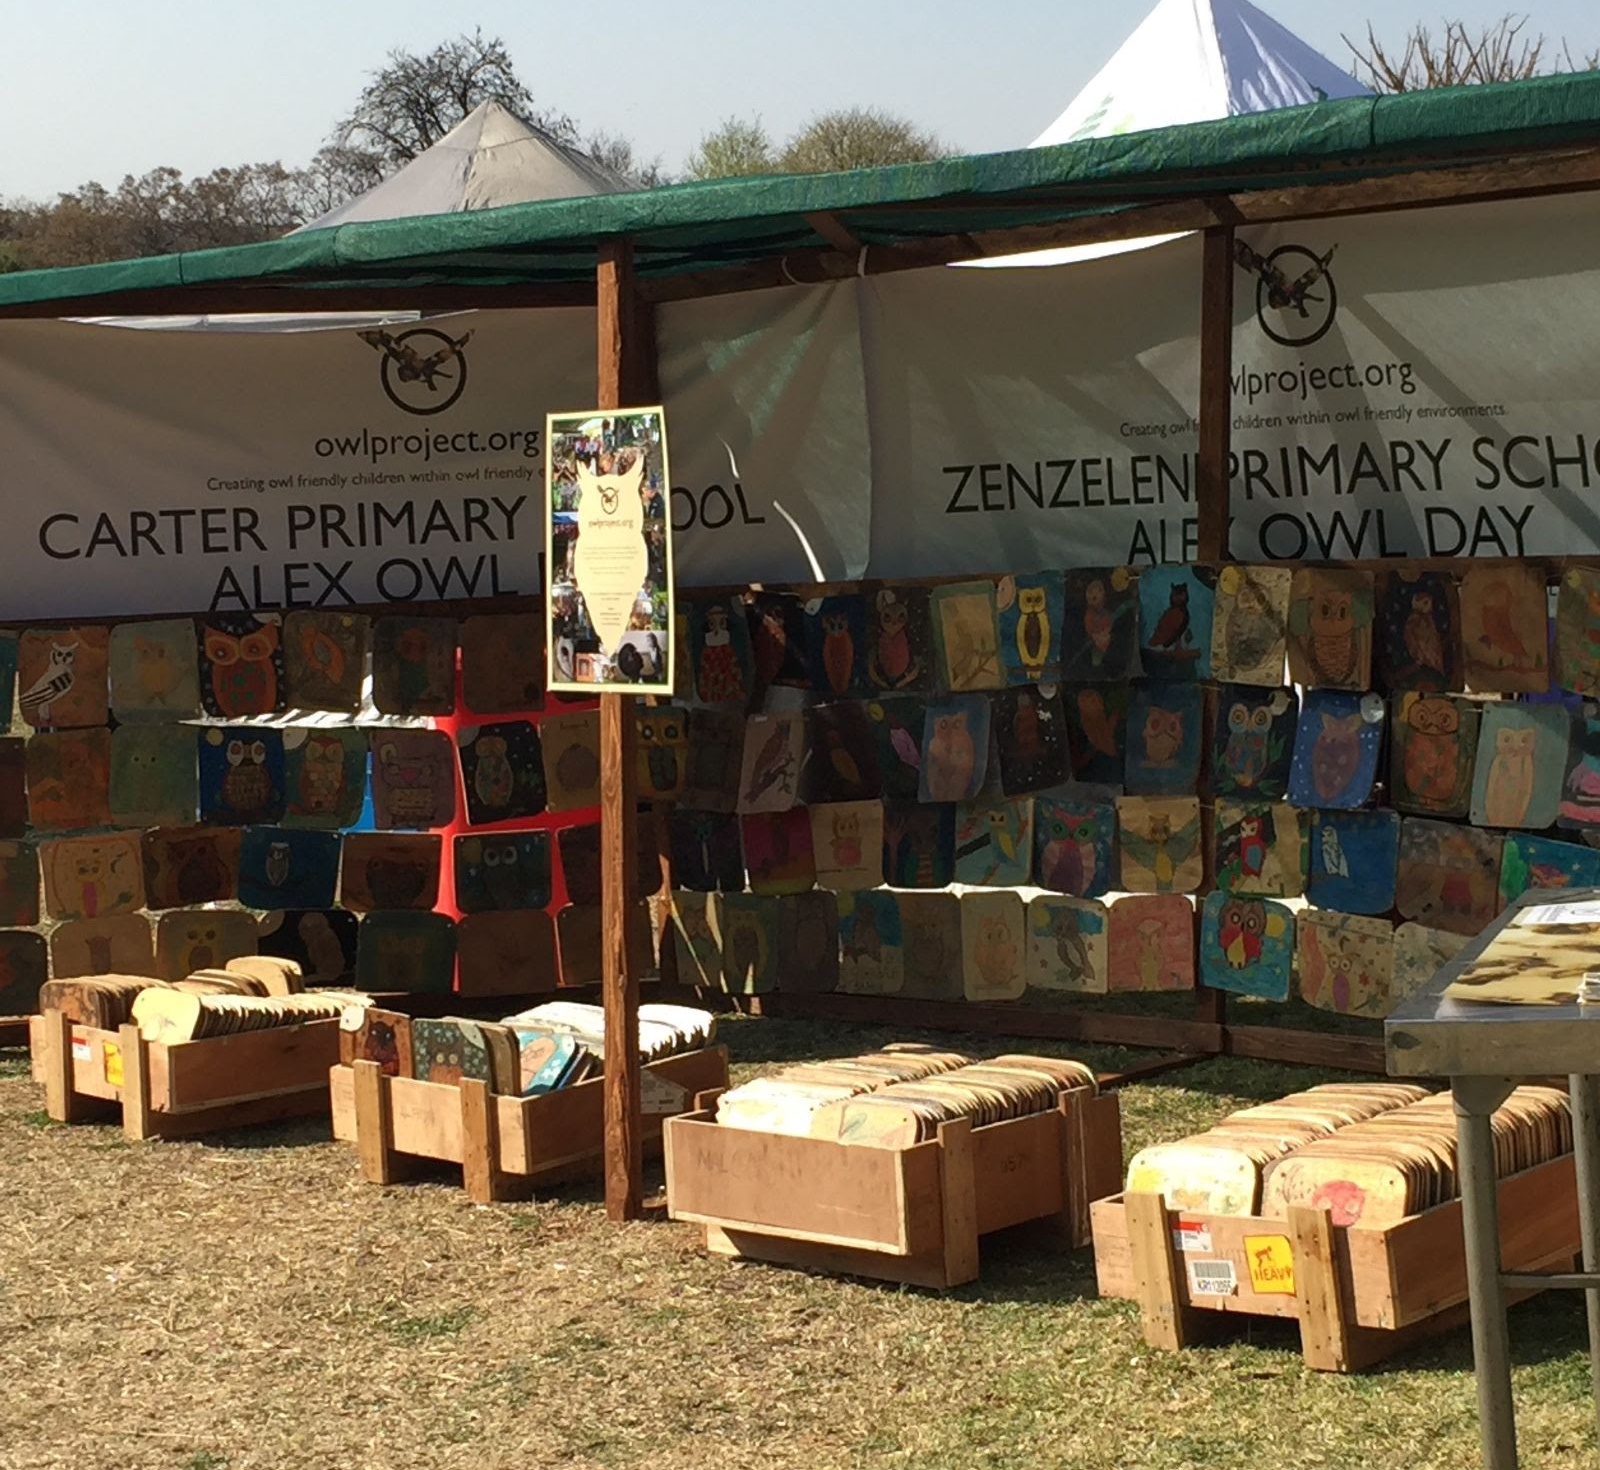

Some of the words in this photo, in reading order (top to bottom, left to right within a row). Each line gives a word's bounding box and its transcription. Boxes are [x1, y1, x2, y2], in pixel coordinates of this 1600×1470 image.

[1230, 362, 1417, 405] wlproject.org
[1119, 421, 1168, 439] Creating
[1169, 418, 1191, 434] owl
[1232, 412, 1282, 431] children
[1286, 409, 1331, 427] within
[1335, 408, 1361, 425] owl
[1363, 404, 1413, 424] friendly
[314, 427, 540, 464] owlproject.org
[1471, 433, 1600, 491] SCH
[206, 476, 266, 493] Creating
[268, 474, 294, 489] owl
[297, 473, 348, 489] friendly
[351, 471, 406, 487] children
[409, 469, 450, 483] within
[454, 467, 480, 482] owl
[483, 465, 534, 482] friendly
[38, 505, 268, 560] CARTER
[286, 495, 528, 550] PRIMARY
[1258, 509, 1408, 561] OWL
[1424, 504, 1535, 558] DAY
[208, 560, 356, 613] ALEX
[375, 553, 519, 601] OWL
[1253, 1265, 1293, 1282] HEAVY
